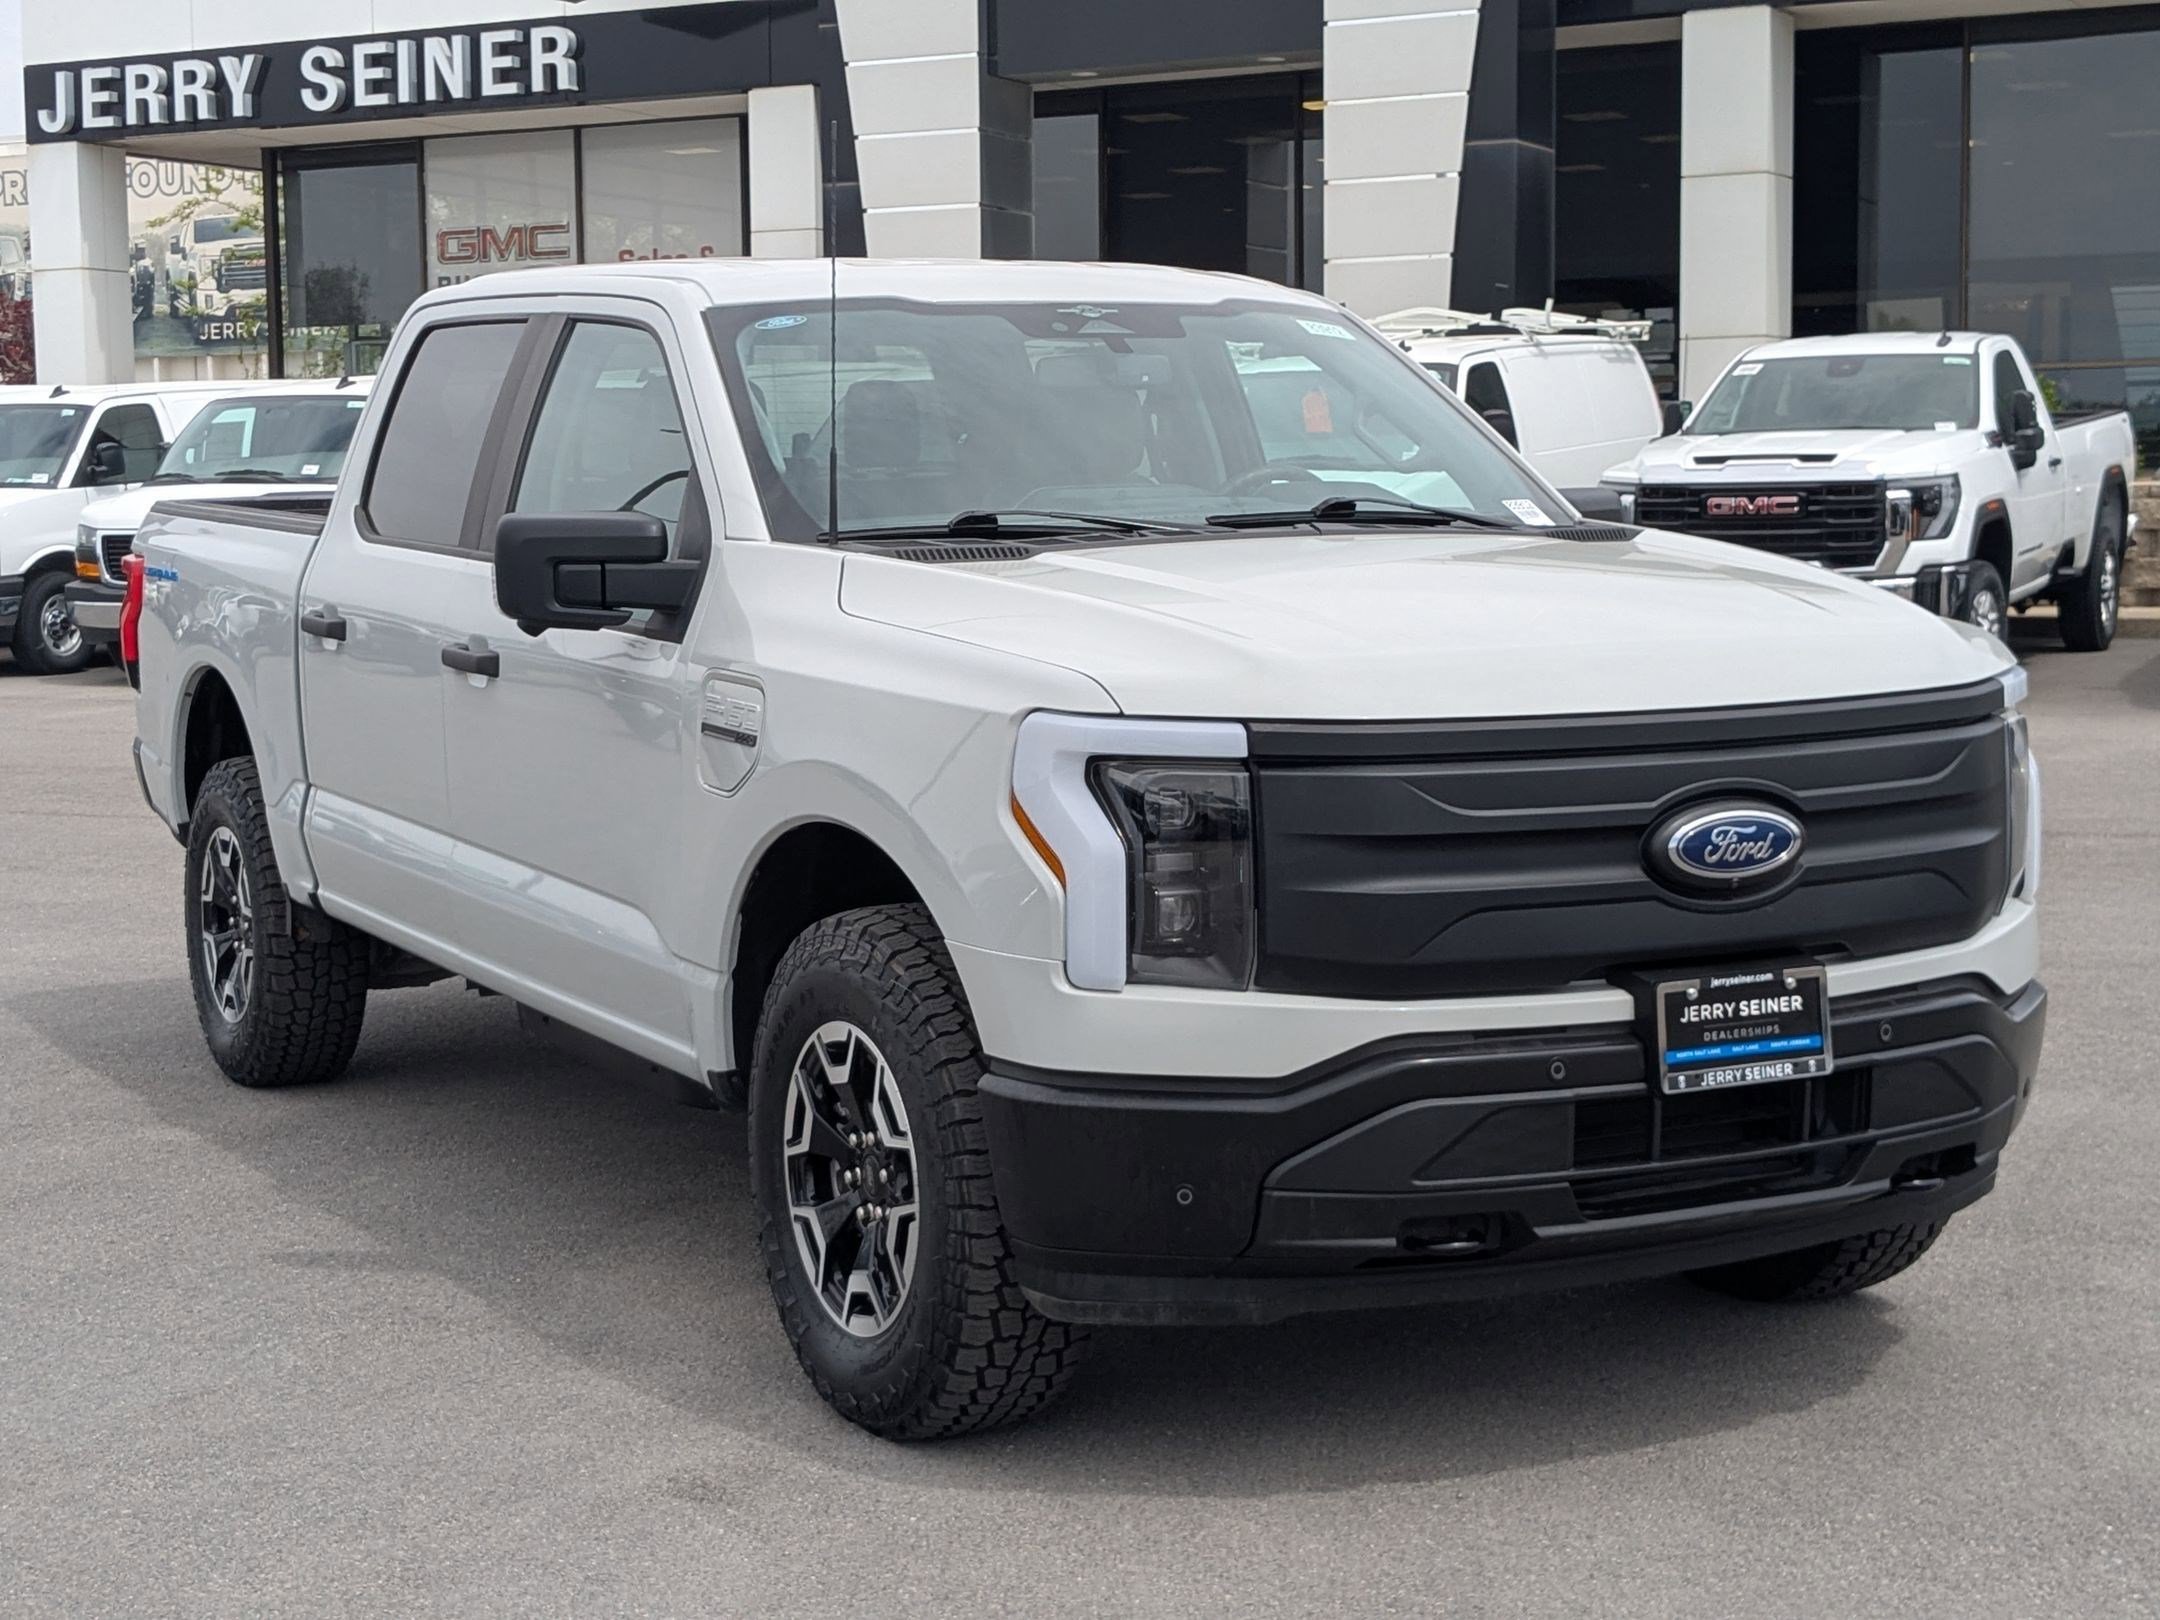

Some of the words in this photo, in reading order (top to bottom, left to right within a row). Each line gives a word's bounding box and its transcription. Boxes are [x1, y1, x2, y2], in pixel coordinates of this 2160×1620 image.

[38, 54, 263, 135] JERRY
[301, 25, 580, 113] SEINER
[436, 221, 571, 265] GMC
[200, 321, 262, 341] JERRY
[1706, 495, 1800, 515] GMC
[1704, 825, 1776, 864] Ford
[1710, 972, 1774, 989] jerryseiner.com
[1680, 1002, 1737, 1023] JERRY
[1739, 995, 1803, 1017] SEINER
[1703, 1024, 1781, 1042] DEALERSHIPS
[1701, 1068, 1743, 1087] JERRY
[1745, 1062, 1794, 1081] SEINER
